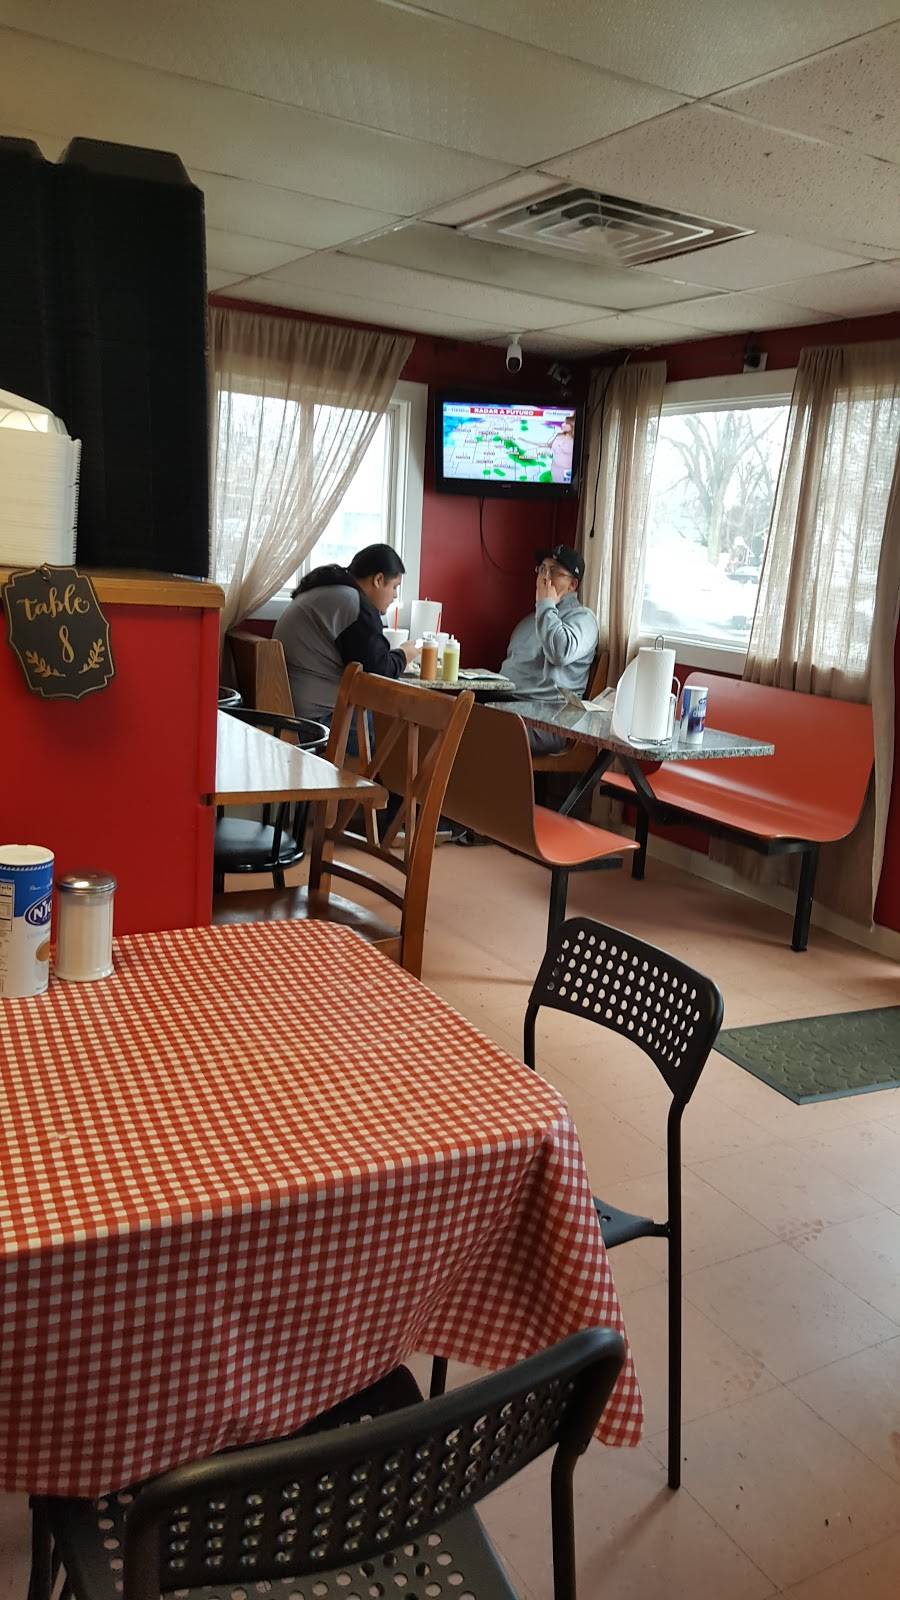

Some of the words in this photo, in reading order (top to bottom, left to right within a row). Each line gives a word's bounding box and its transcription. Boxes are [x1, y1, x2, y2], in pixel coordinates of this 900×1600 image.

[474, 407, 498, 415] RADAR
[506, 409, 534, 417] FUTURO
[16, 583, 90, 621] table
[58, 625, 75, 663] 8
